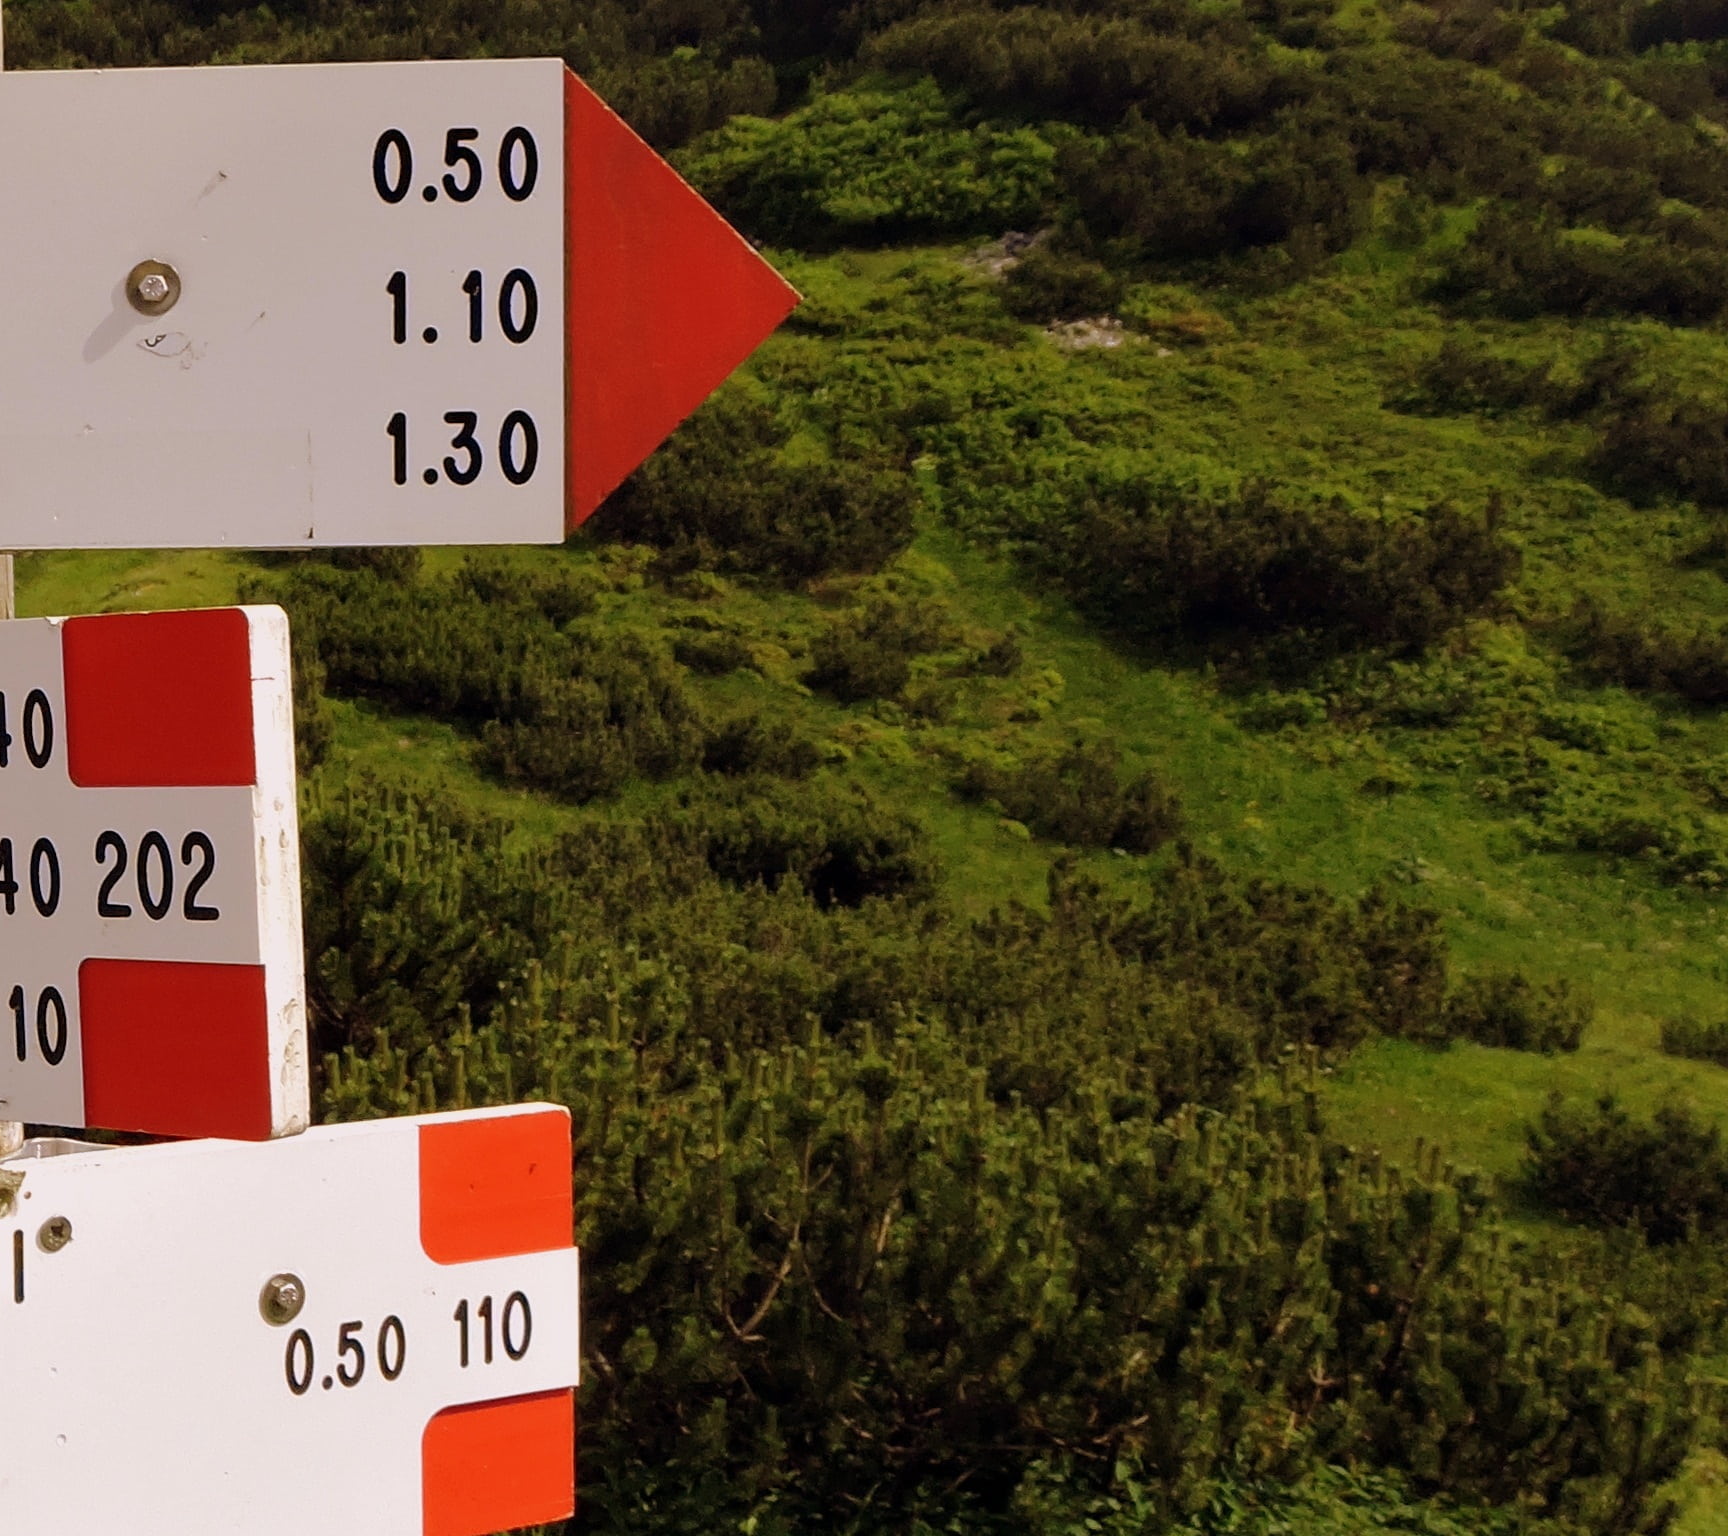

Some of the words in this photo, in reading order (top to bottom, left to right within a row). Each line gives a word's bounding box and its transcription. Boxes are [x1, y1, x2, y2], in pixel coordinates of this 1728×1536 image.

[372, 126, 538, 204] 0.50
[386, 268, 538, 344] 1.10
[387, 410, 538, 486] 1.30
[95, 831, 220, 921] 202
[283, 1314, 406, 1395] 0.50
[454, 1290, 532, 1368] 110
